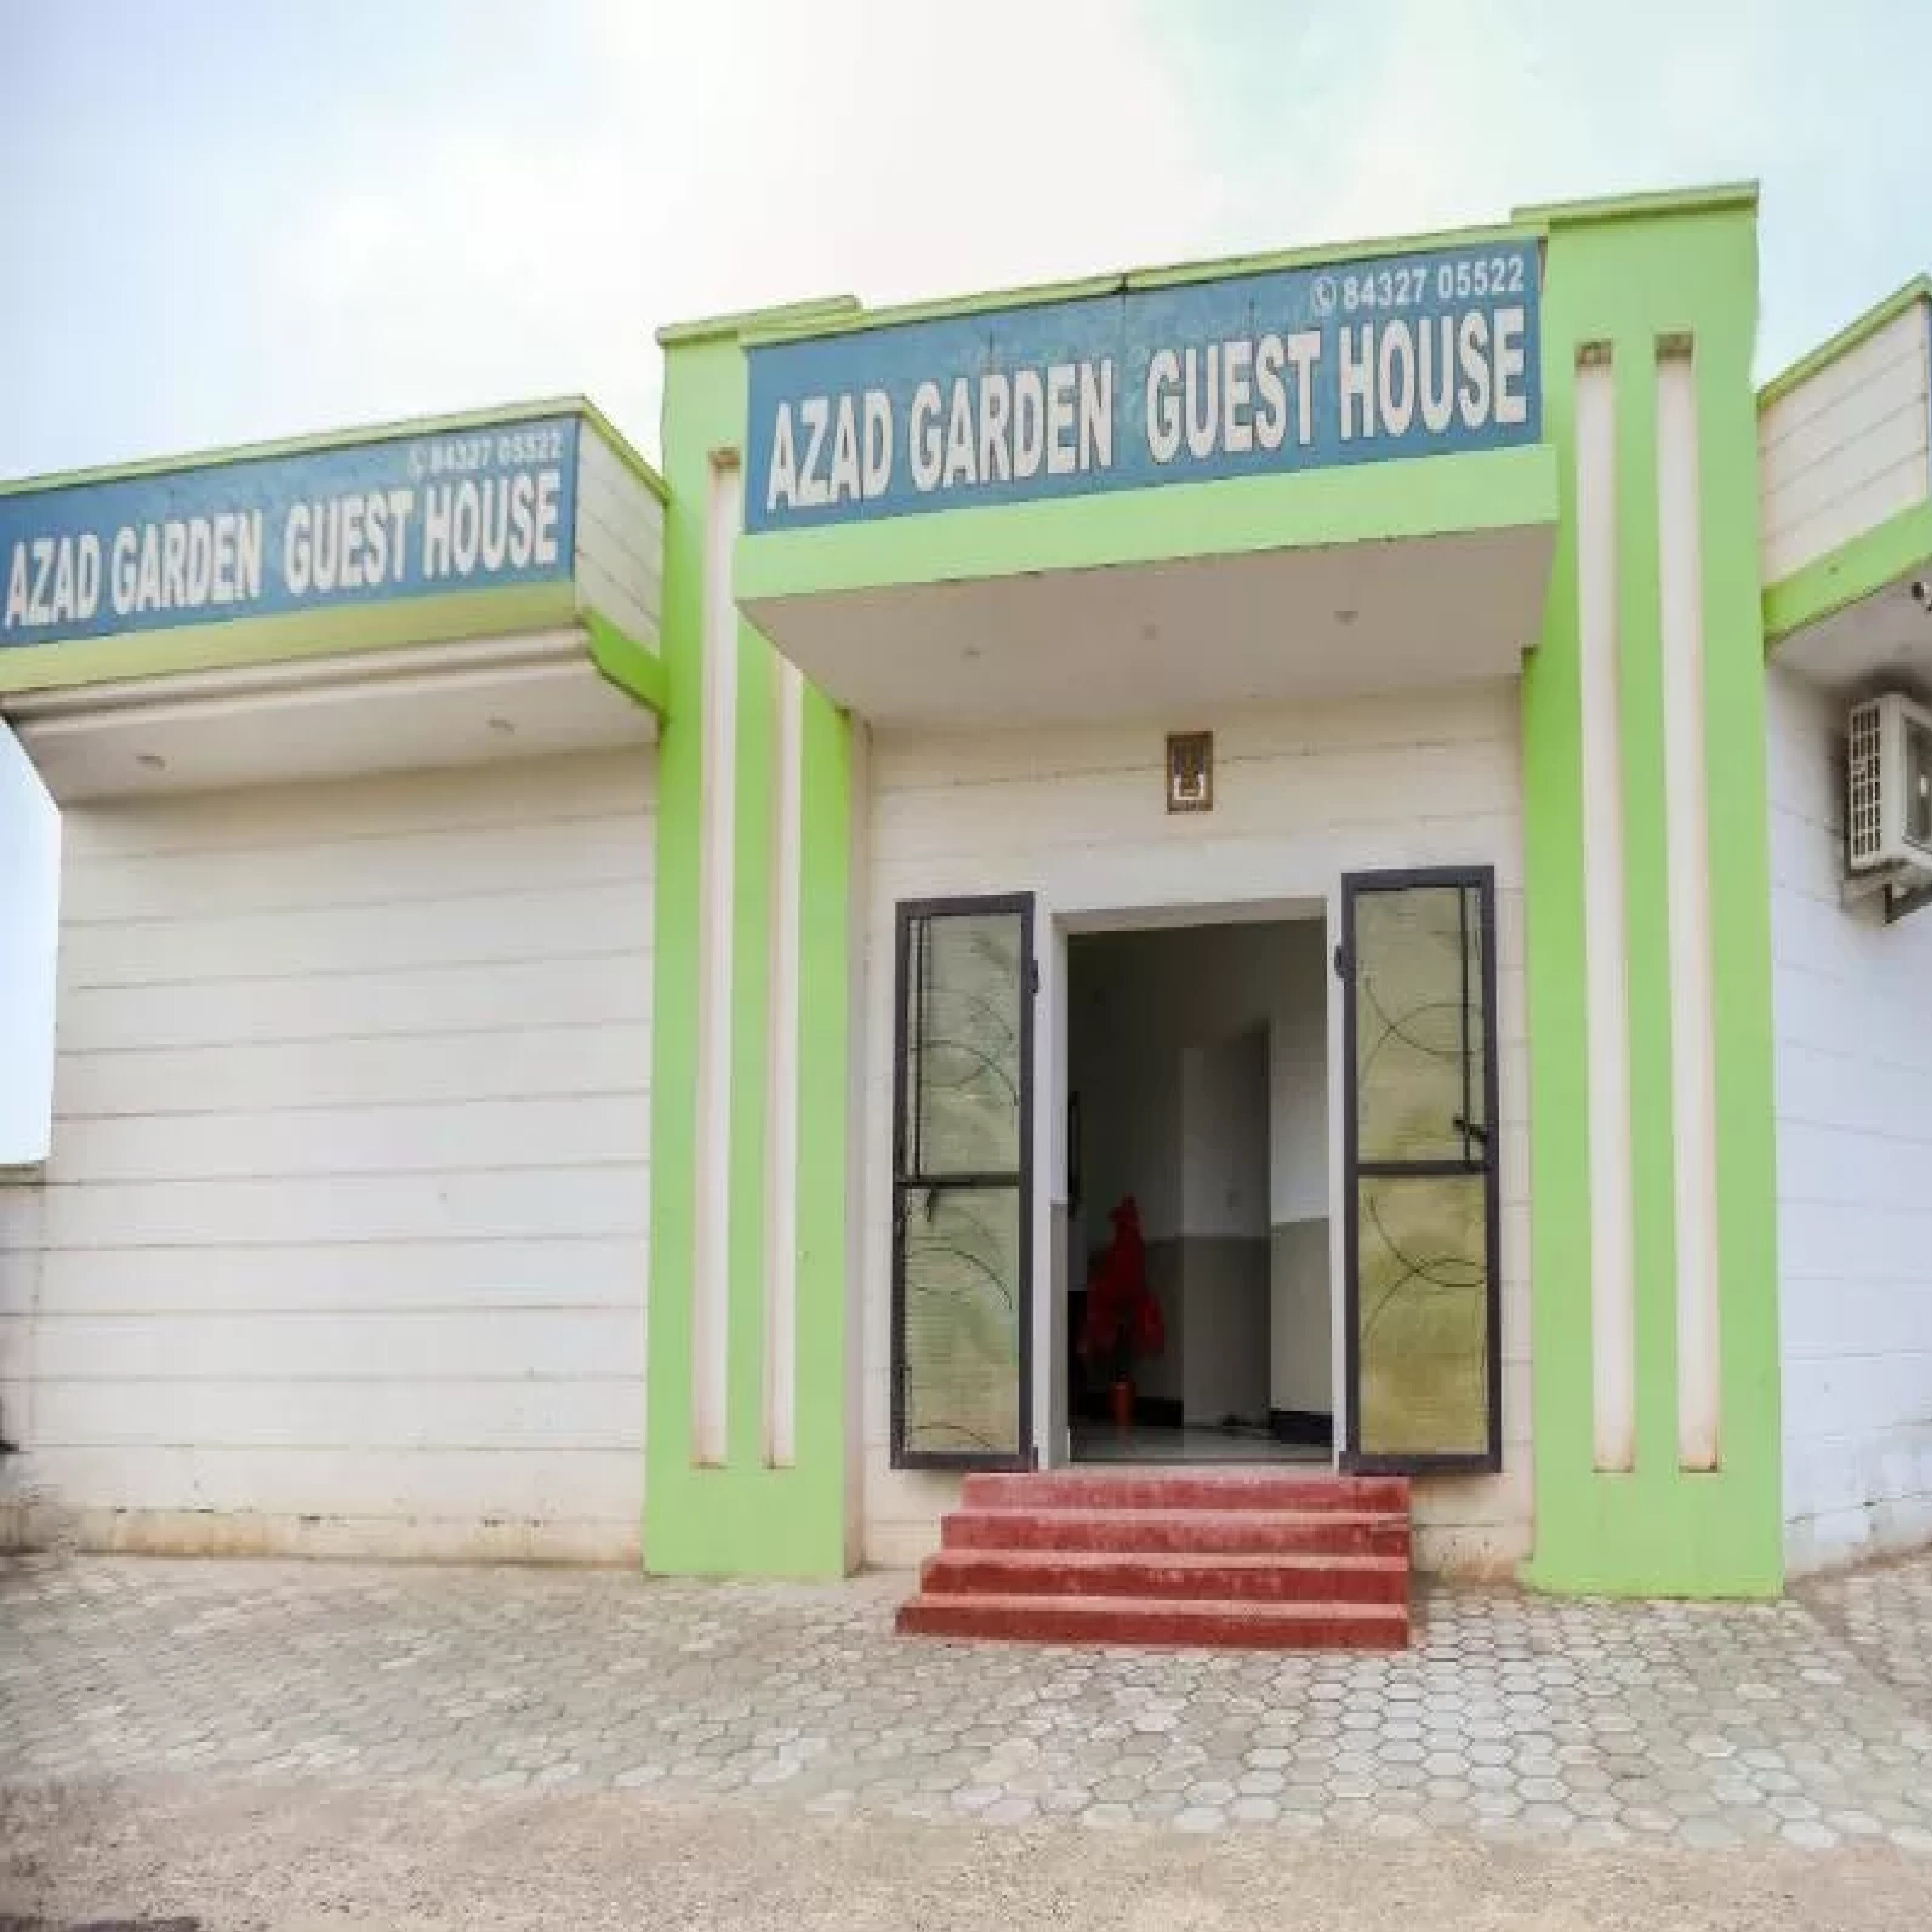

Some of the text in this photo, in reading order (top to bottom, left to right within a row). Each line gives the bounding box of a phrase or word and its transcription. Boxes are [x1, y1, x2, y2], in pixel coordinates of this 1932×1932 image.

[1343, 254, 1524, 312] 84327 05522
[766, 309, 1526, 513] AZAD GARDEN GUEST HOUSE
[4, 473, 560, 629] AZAD GARDEN GUEST HOUSE
